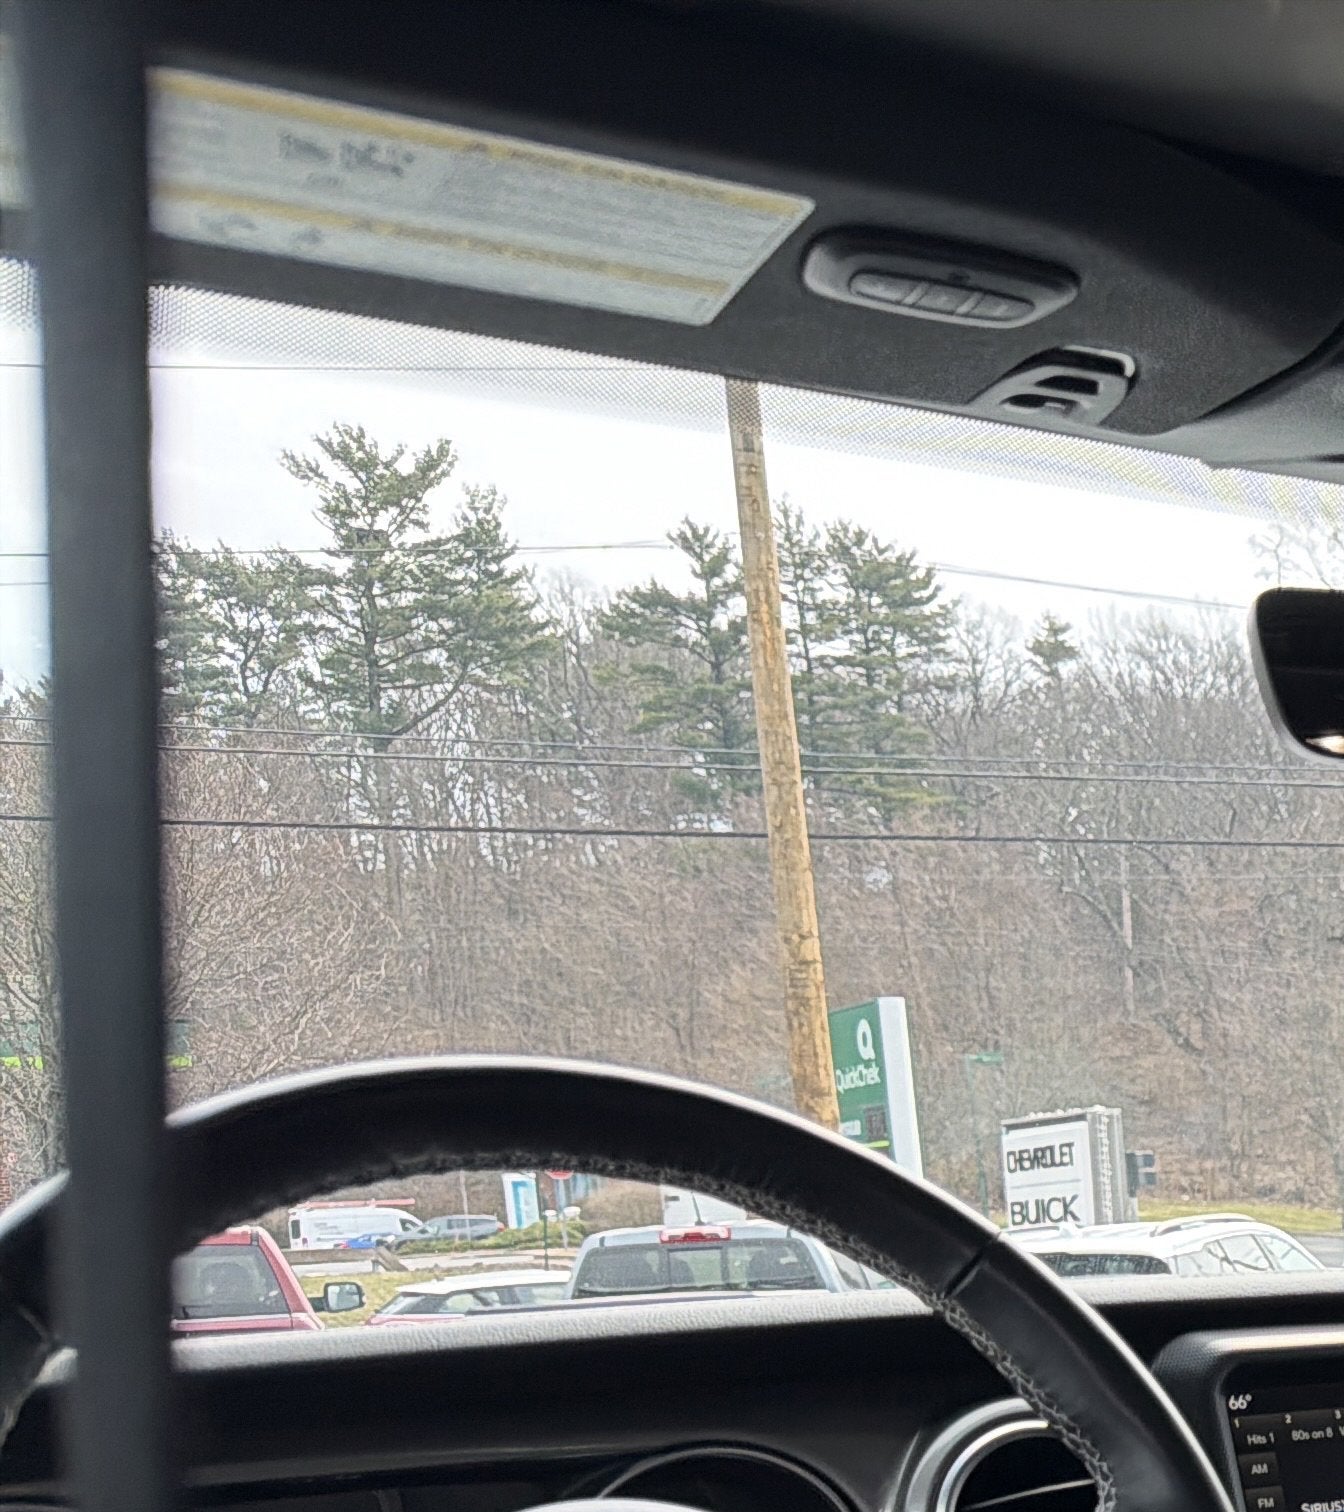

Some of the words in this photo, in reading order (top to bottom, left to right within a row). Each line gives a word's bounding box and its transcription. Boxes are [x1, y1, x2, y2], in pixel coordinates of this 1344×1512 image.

[1010, 1194, 1080, 1226] BUICK
[1251, 1462, 1269, 1475] AM
[1258, 1497, 1275, 1510] FM
